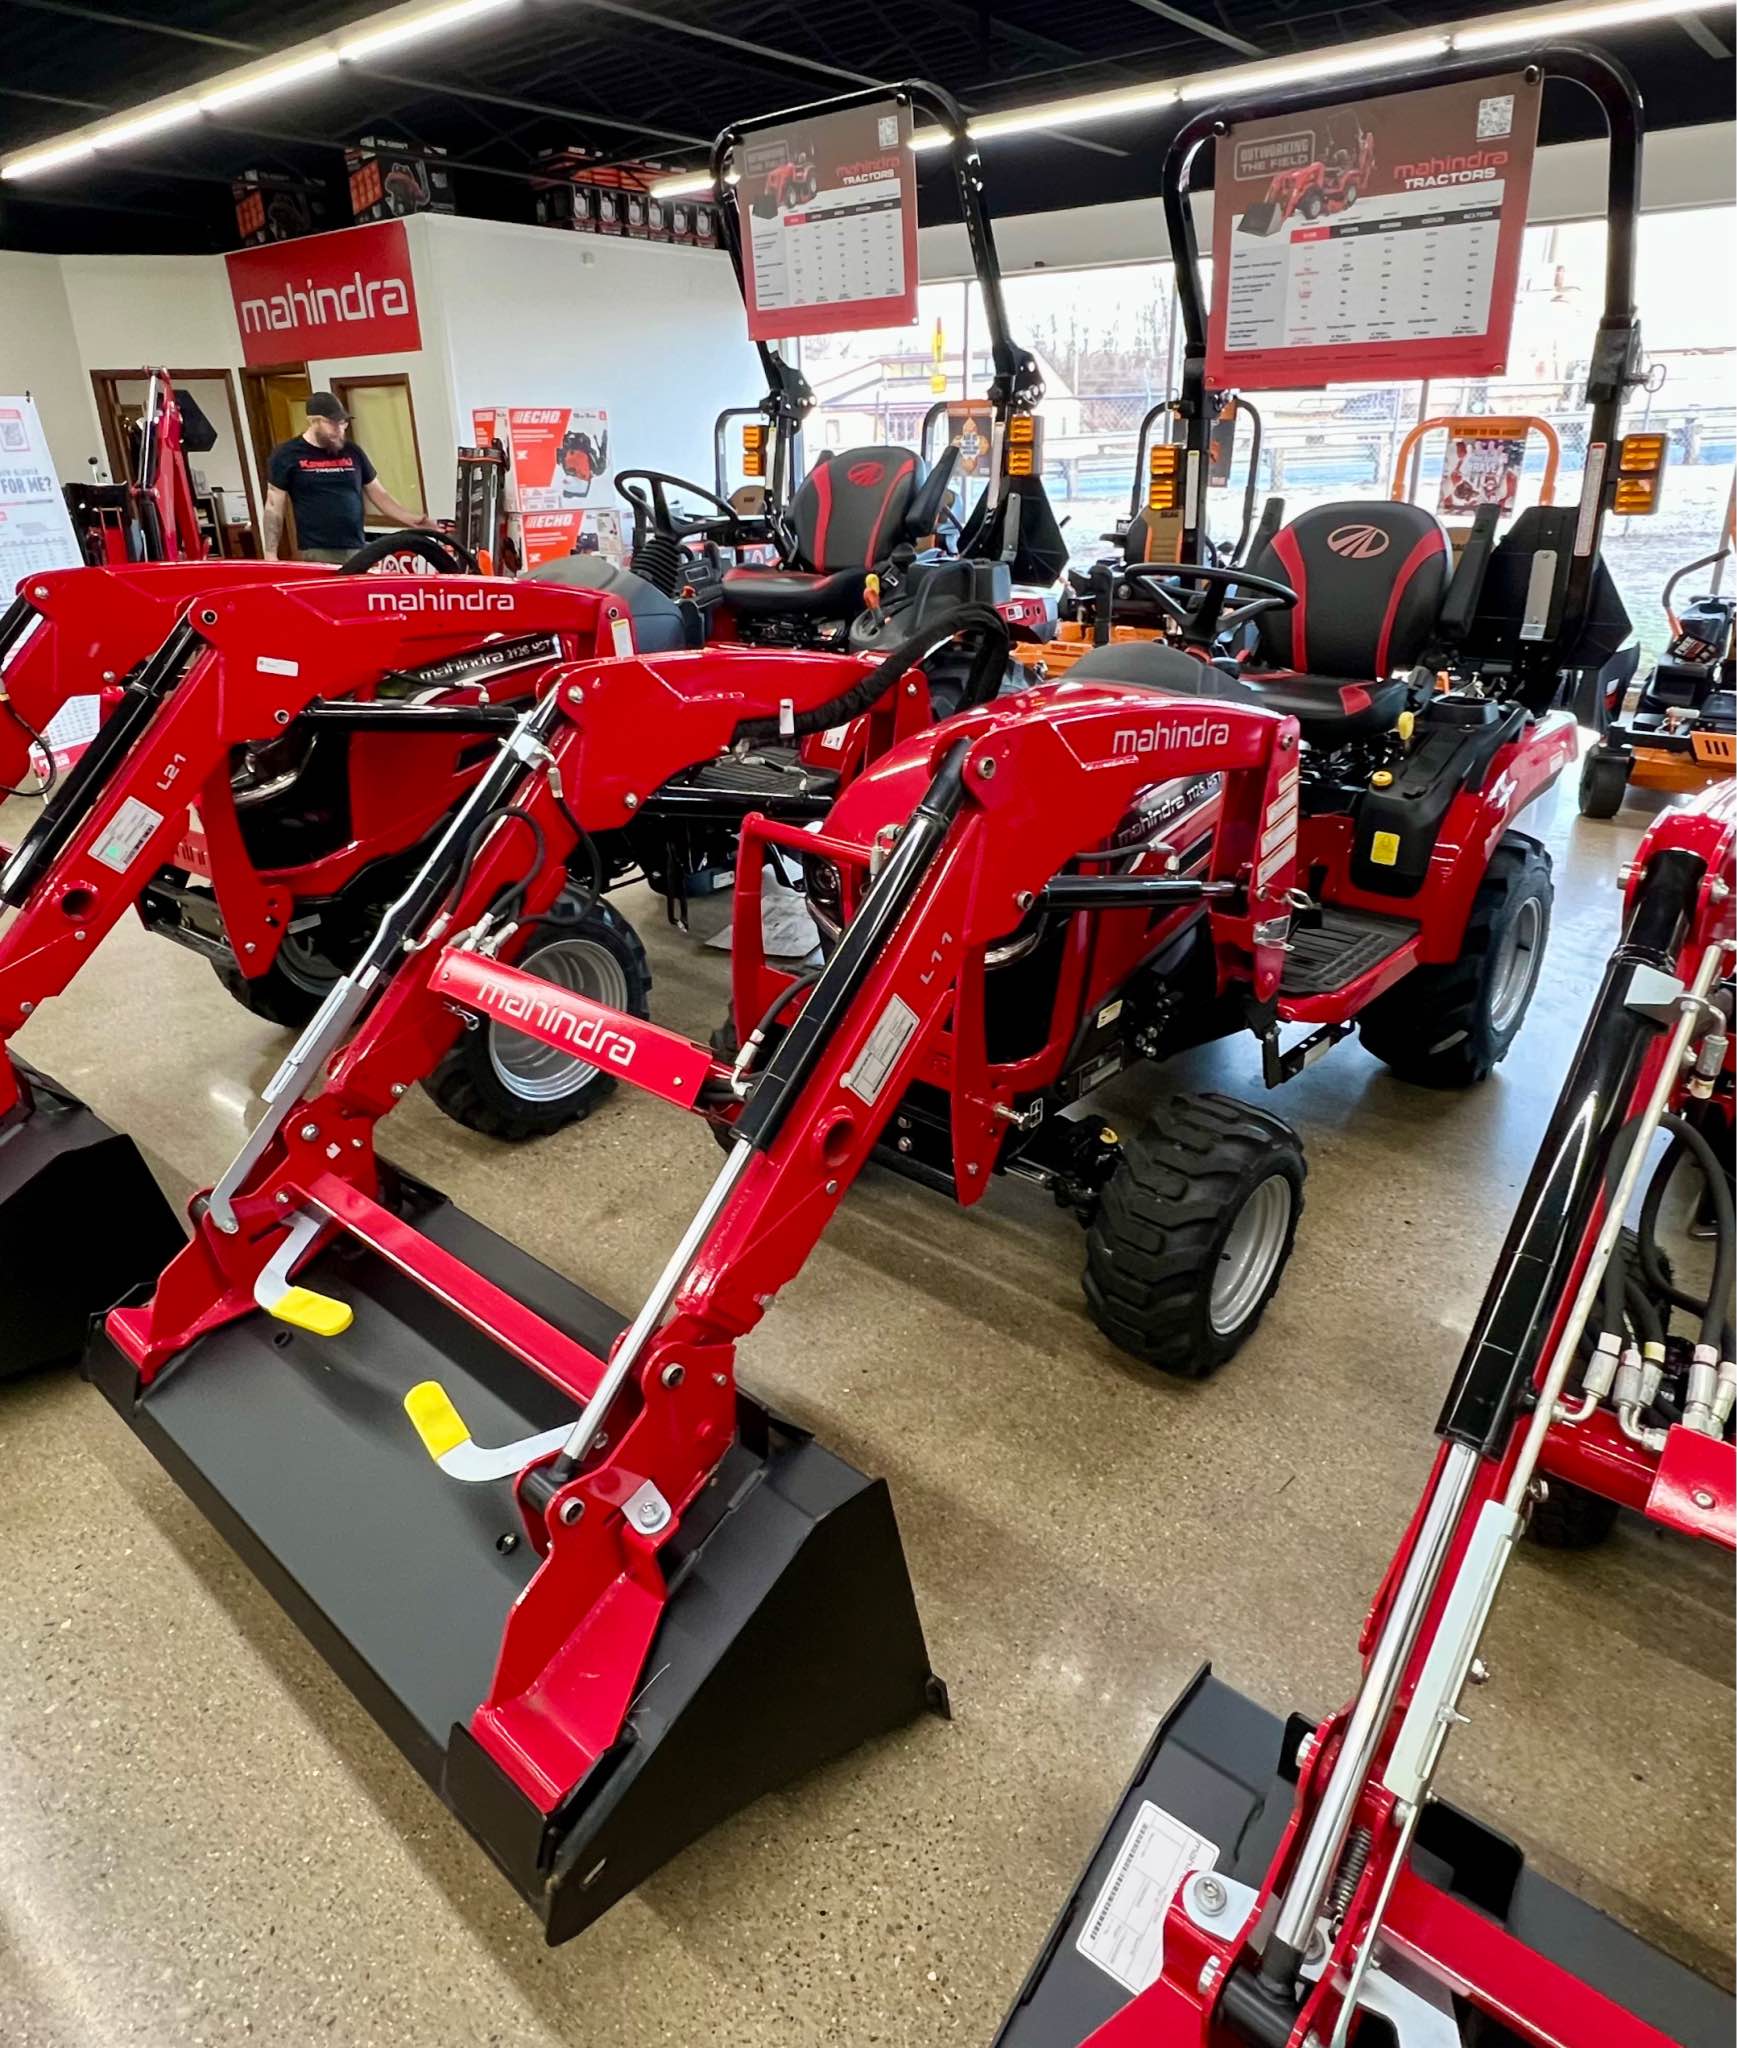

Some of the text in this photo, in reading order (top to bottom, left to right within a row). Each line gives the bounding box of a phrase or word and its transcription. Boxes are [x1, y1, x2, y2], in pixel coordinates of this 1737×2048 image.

[1270, 154, 1309, 169] FIELD
[1392, 150, 1509, 179] mahindra
[842, 168, 895, 186] TRACTORS
[1404, 167, 1496, 190] TRACTORS
[240, 271, 409, 334] mahindra
[522, 411, 561, 424] ECHO
[0, 476, 52, 495] FOR ME?
[536, 514, 574, 527] ECHO
[368, 588, 515, 612] mahindra
[419, 651, 504, 681] mahindra
[1112, 718, 1230, 754] mahindra
[156, 753, 187, 791] L21
[1117, 795, 1187, 847] mahindra
[920, 931, 953, 985] L11
[477, 978, 637, 1068] mahindra
